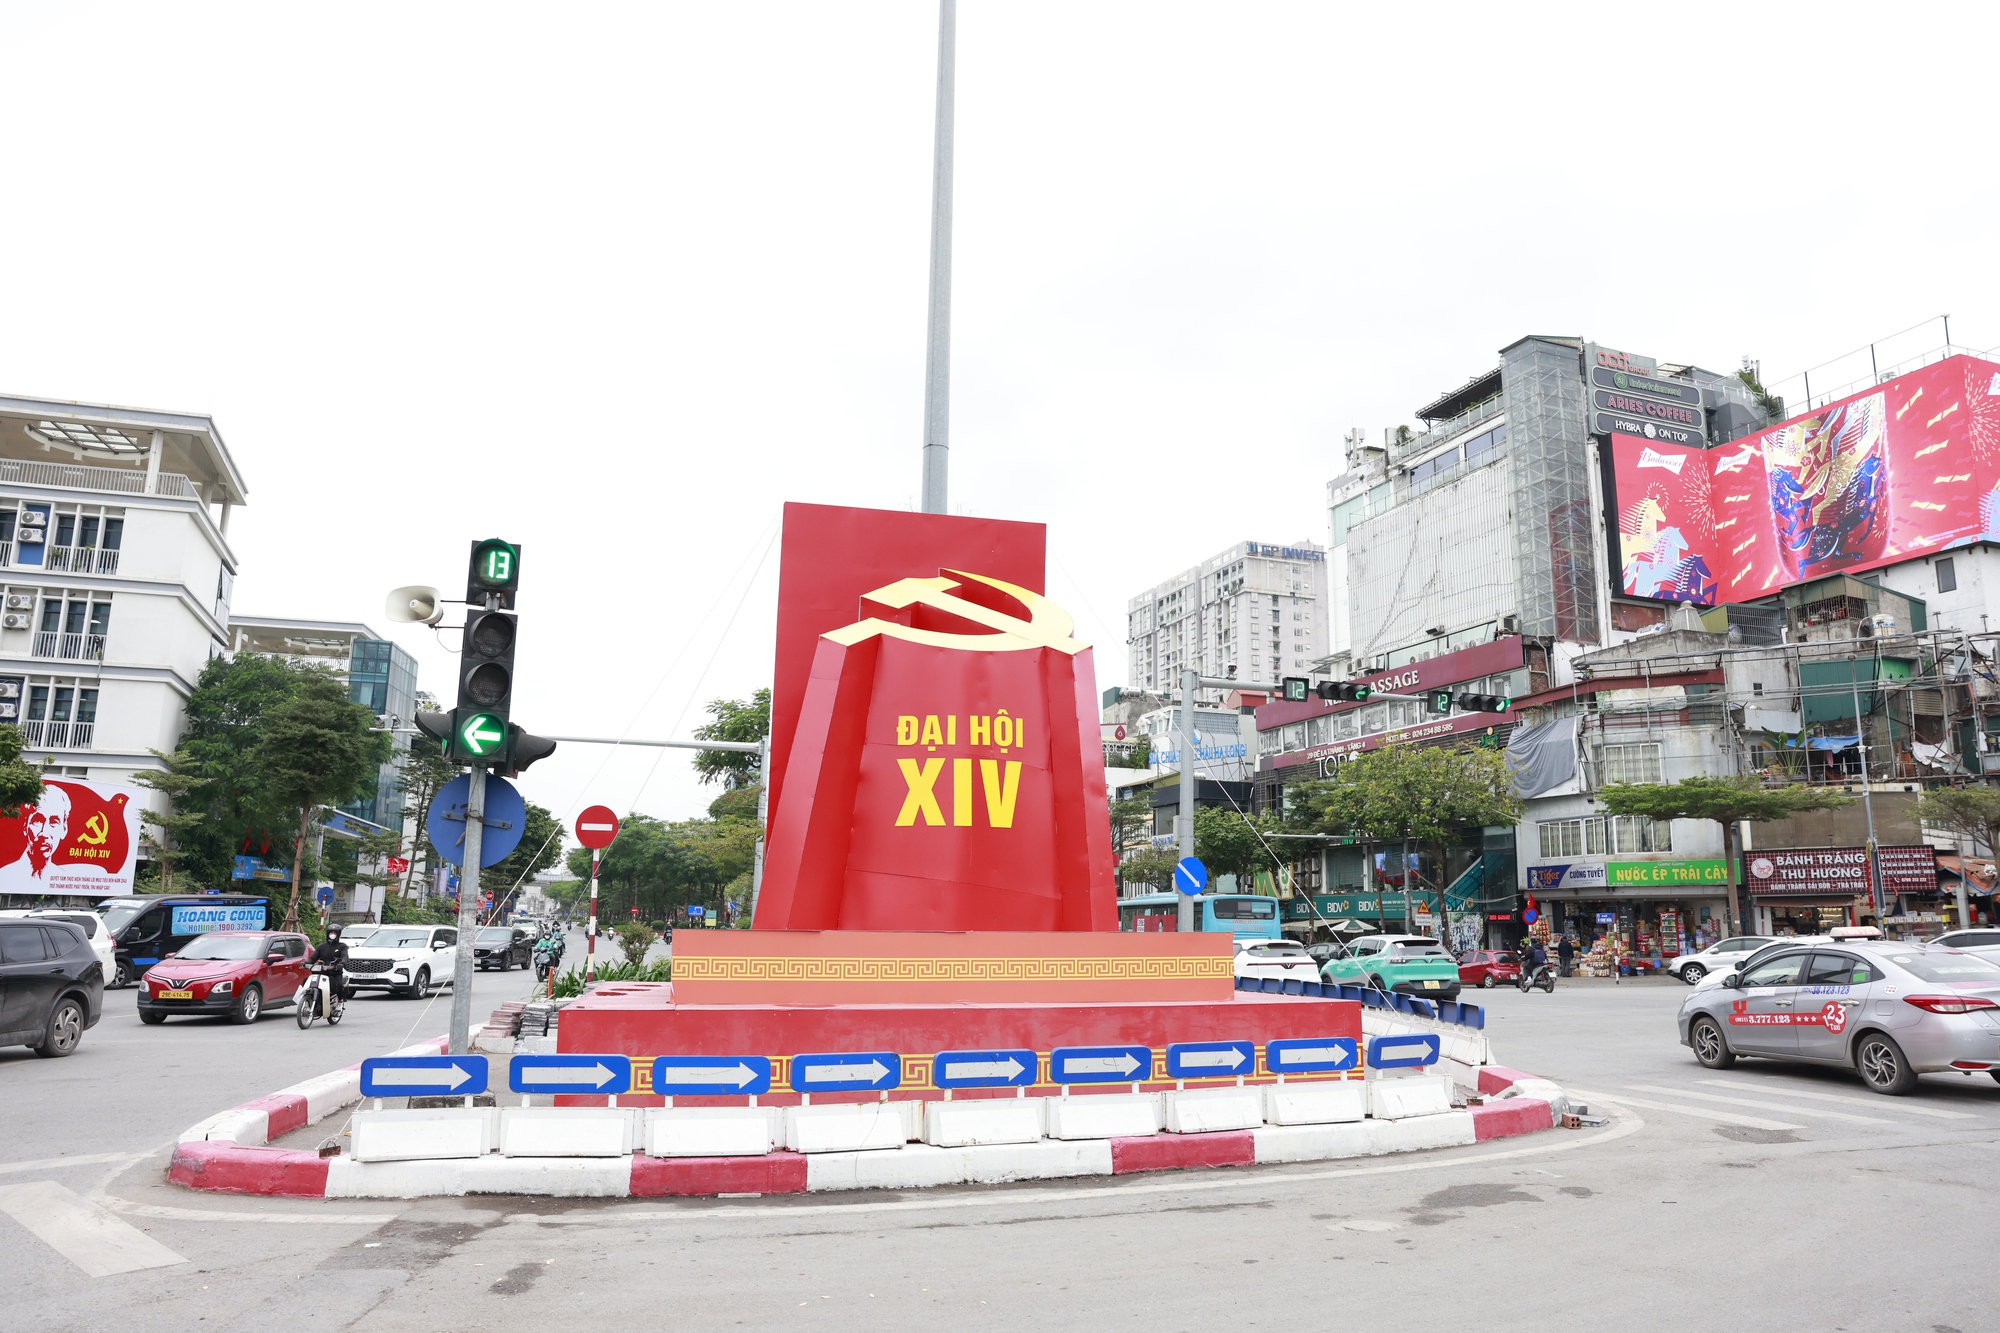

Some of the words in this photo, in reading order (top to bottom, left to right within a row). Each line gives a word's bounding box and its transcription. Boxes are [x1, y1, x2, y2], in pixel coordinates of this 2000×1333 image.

[1629, 365, 1651, 374] GROUP
[1629, 378, 1681, 396] Entertainment
[1607, 395, 1643, 413] ARIES
[1646, 403, 1692, 422] COFFEE
[1615, 420, 1641, 433] HYBRA
[1659, 428, 1671, 439] ON
[1672, 431, 1688, 442] TOP
[1641, 451, 1682, 467] Budweiser
[1718, 453, 1751, 469] Budweiser
[1262, 545, 1280, 556] GP
[1282, 547, 1327, 561] INVEST
[488, 551, 510, 579] 13
[1370, 670, 1420, 693] ASSAGE
[1292, 681, 1305, 699] 12
[1437, 694, 1448, 711] 12
[896, 714, 957, 751] ĐẠI
[969, 708, 1024, 753] HỘI
[1226, 744, 1246, 758] LONG
[894, 757, 1022, 828] XIV
[69, 847, 82, 858] ĐẠI
[84, 847, 97, 859] HỘI
[98, 849, 111, 858] XIV
[1776, 853, 1814, 866] BÁNH
[1817, 851, 1866, 864] TRÁNG
[1538, 869, 1560, 885] Tiger
[1587, 867, 1604, 878] TUYẾT
[1616, 866, 1649, 881] NƯỚC
[1652, 866, 1668, 880] ÉP
[1672, 865, 1700, 880] TRÁI
[1704, 864, 1728, 880] CÂY
[1780, 869, 1806, 880] THU
[1811, 867, 1862, 879] HƯƠNG
[1327, 902, 1343, 913] BIDV
[1358, 900, 1374, 912] BIDV
[177, 909, 226, 923] HOÀNG
[229, 908, 264, 921] CÔNG
[188, 924, 217, 932] Hotline:
[218, 922, 253, 931] 1900.3292
[1748, 1015, 1791, 1024] 3.777.123
[1830, 1023, 1841, 1031] Taxi
